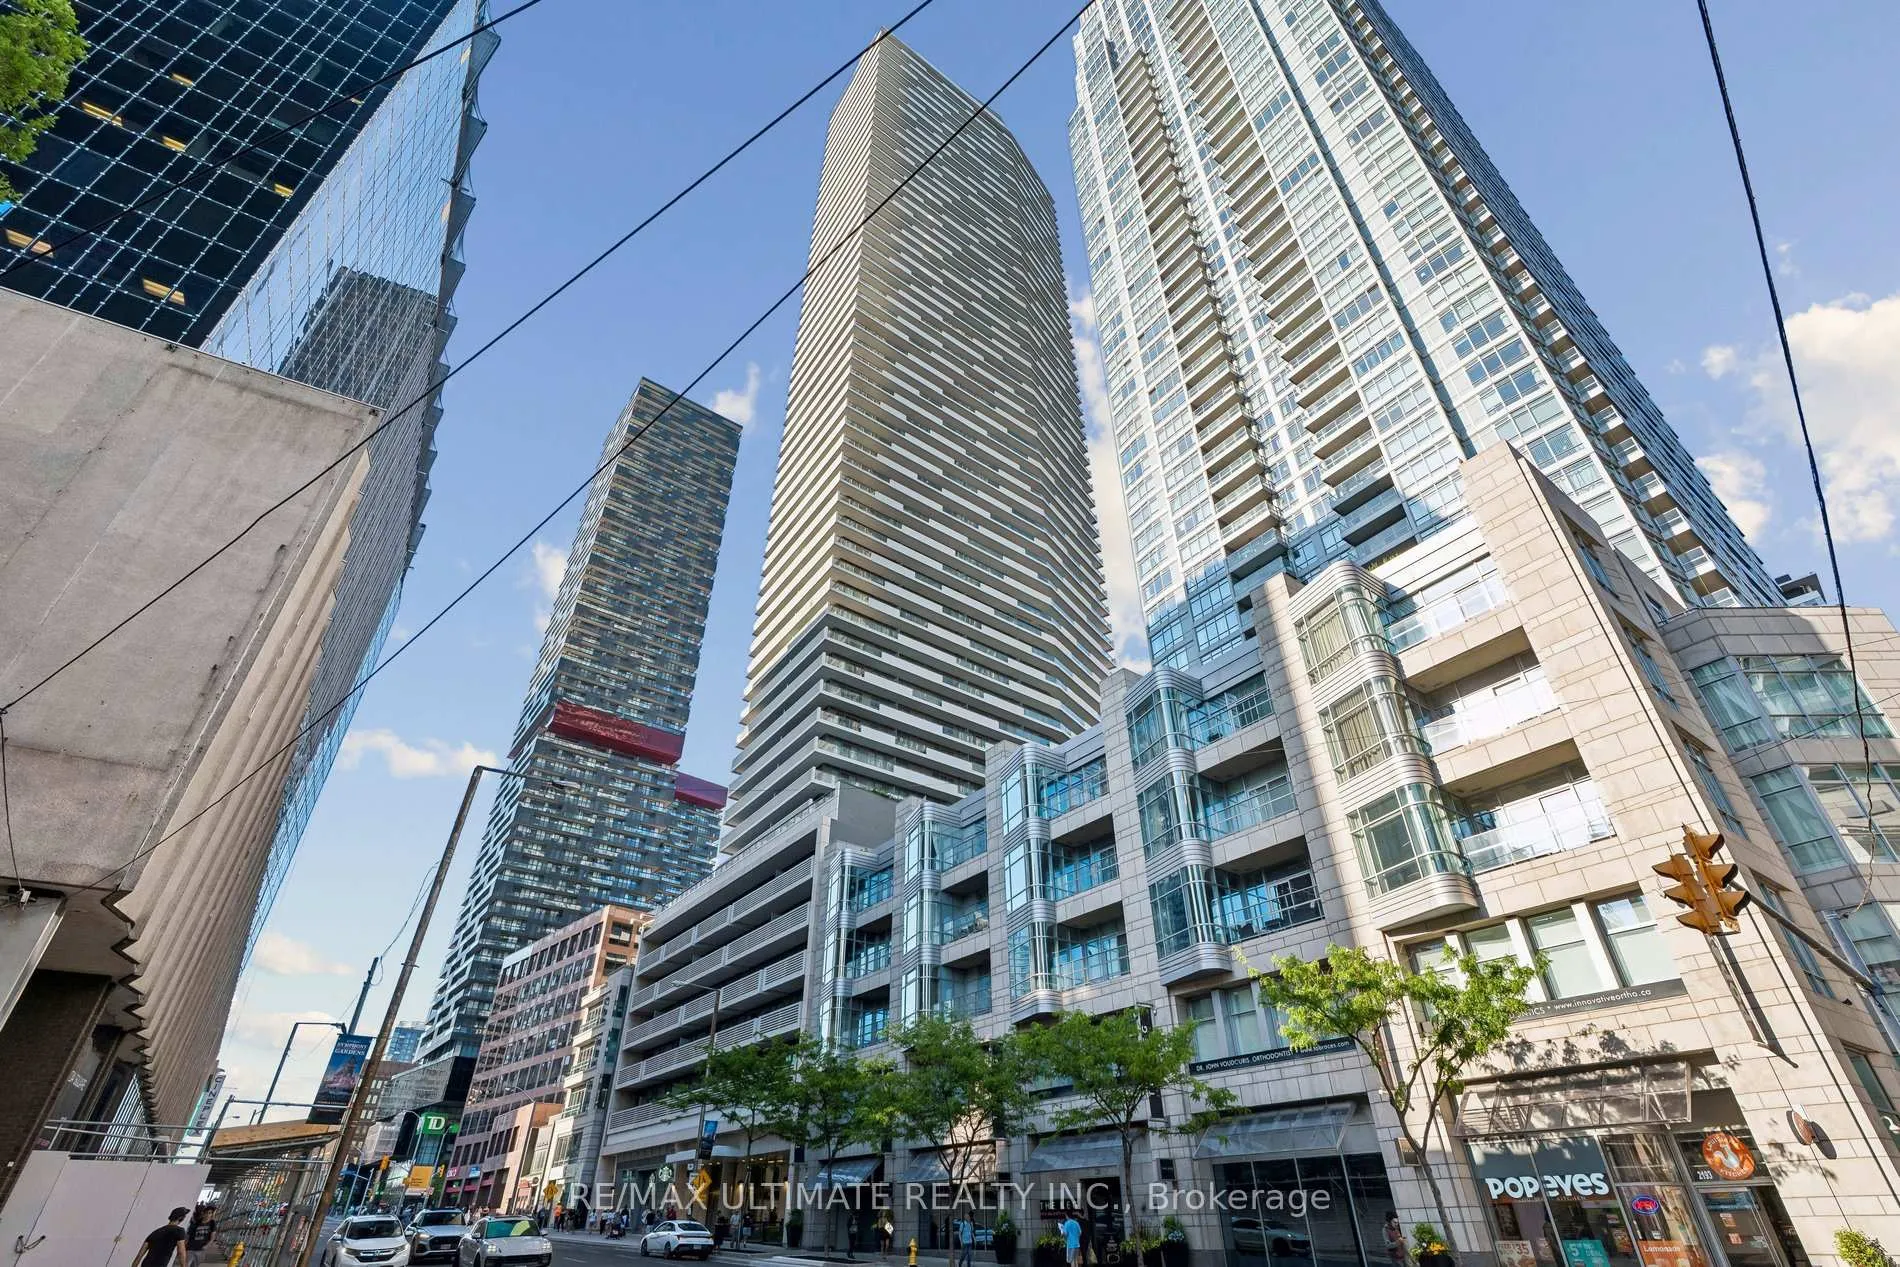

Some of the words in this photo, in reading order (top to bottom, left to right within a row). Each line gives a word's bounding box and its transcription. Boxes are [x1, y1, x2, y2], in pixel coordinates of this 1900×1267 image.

[1554, 989, 1651, 1010] www.innovativeortho.ca
[1205, 1062, 1220, 1071] JOHN
[427, 1116, 446, 1130] TD
